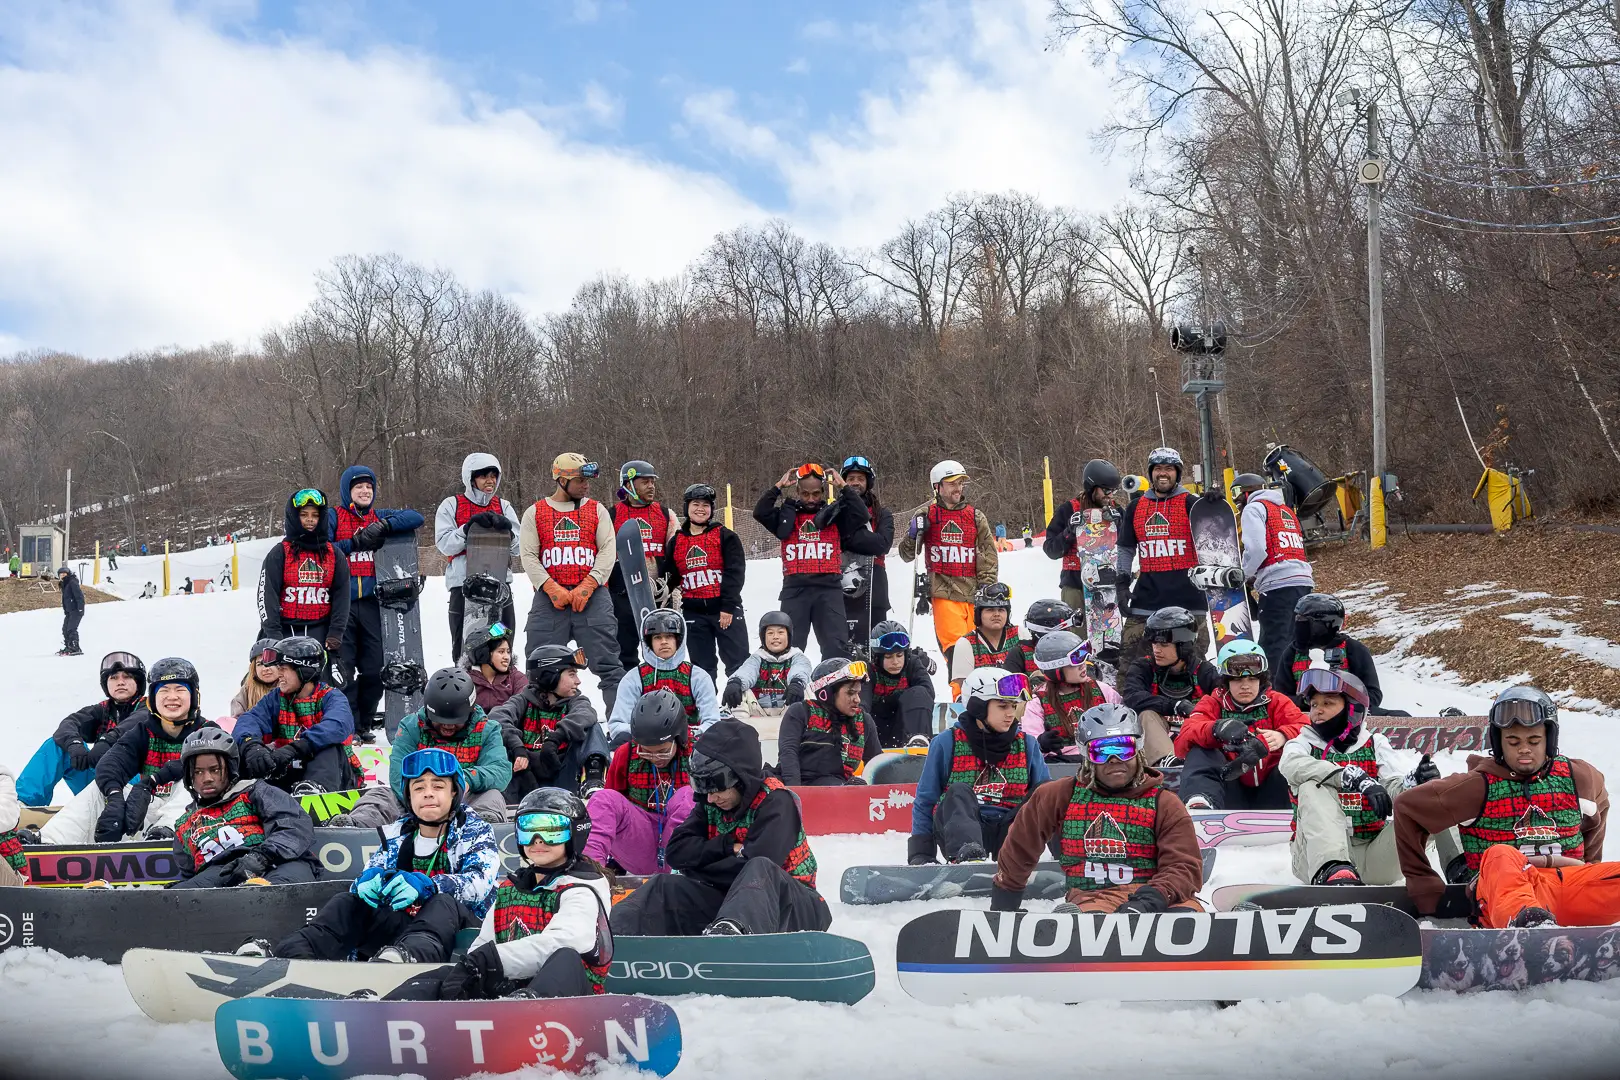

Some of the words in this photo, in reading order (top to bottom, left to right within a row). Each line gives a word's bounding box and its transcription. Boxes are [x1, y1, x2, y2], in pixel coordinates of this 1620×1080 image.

[542, 546, 595, 569] COACH
[785, 542, 834, 561] STAFF
[930, 546, 975, 563] STAFF
[1139, 539, 1186, 558] STAFF
[682, 569, 722, 590] STAFF
[397, 612, 406, 644] CAPITA
[1040, 660, 1064, 669] GIRO
[1084, 861, 1134, 885] 40
[22, 912, 34, 946] RIDE
[954, 903, 1367, 958] SALOMON
